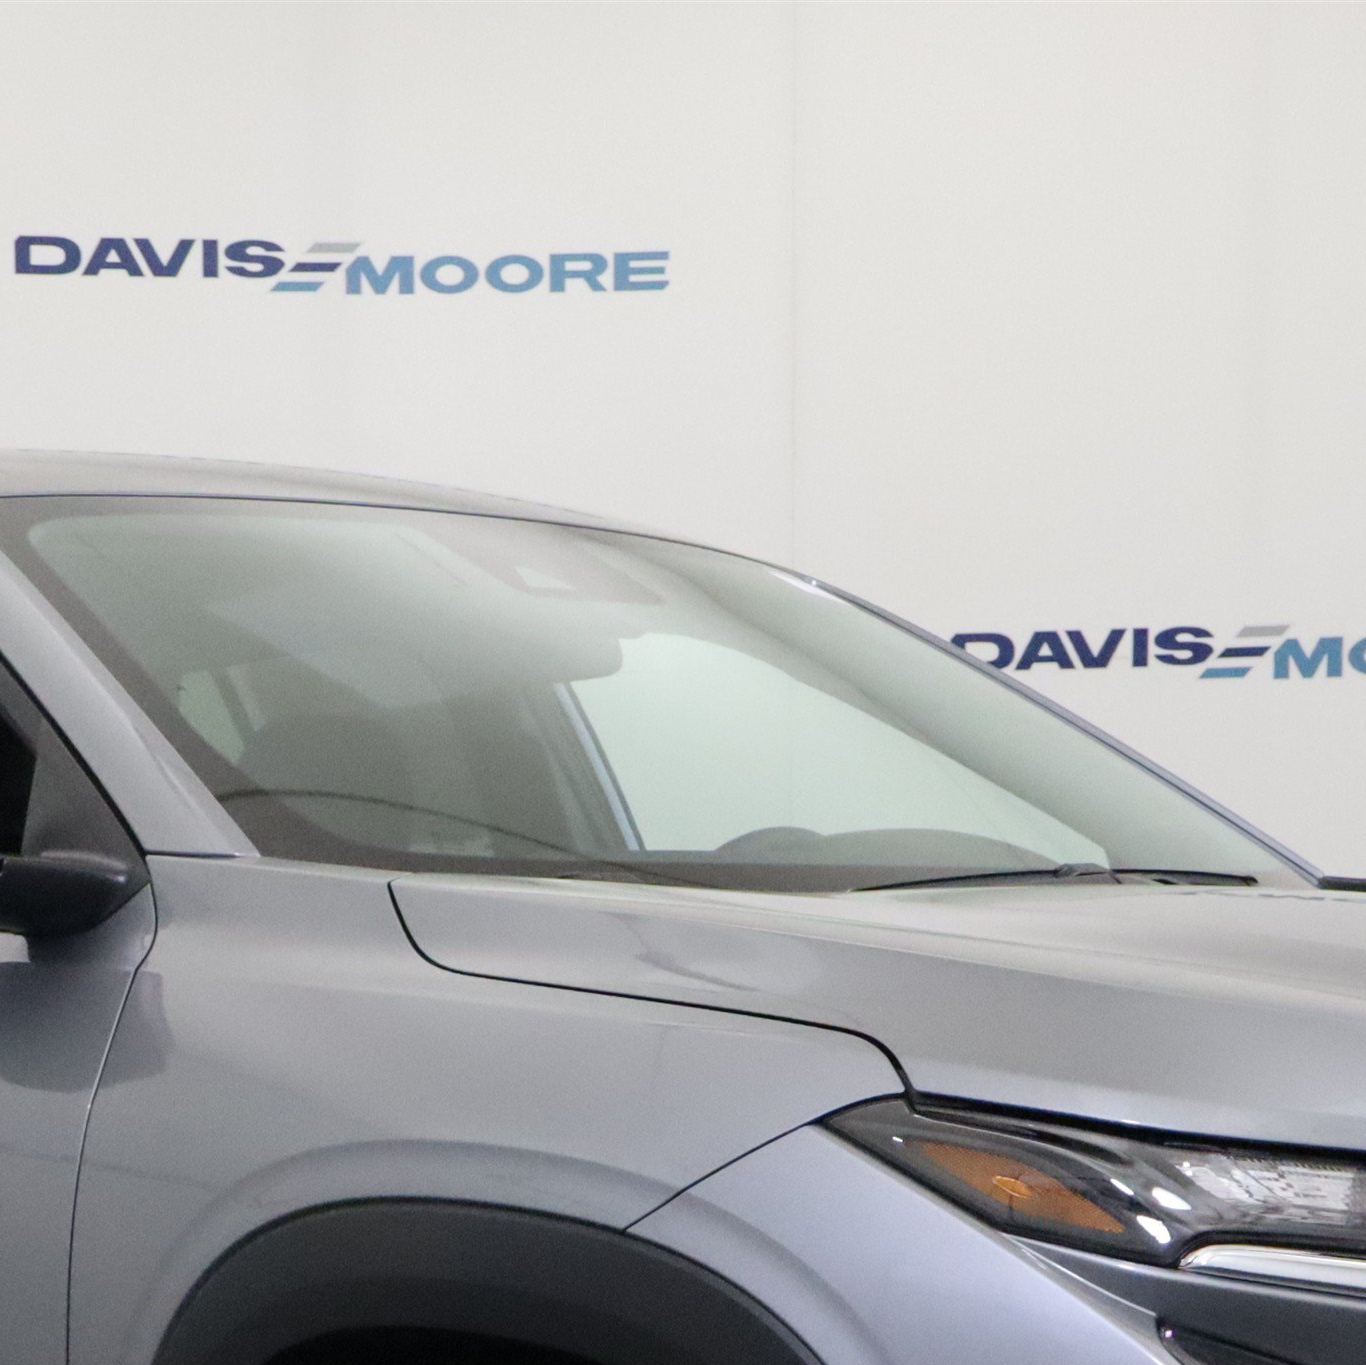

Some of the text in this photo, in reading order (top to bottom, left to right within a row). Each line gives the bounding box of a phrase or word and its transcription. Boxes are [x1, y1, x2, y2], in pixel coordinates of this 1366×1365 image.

[14, 235, 670, 295] DAVIS MOORE
[948, 625, 1214, 671] DAVIS
